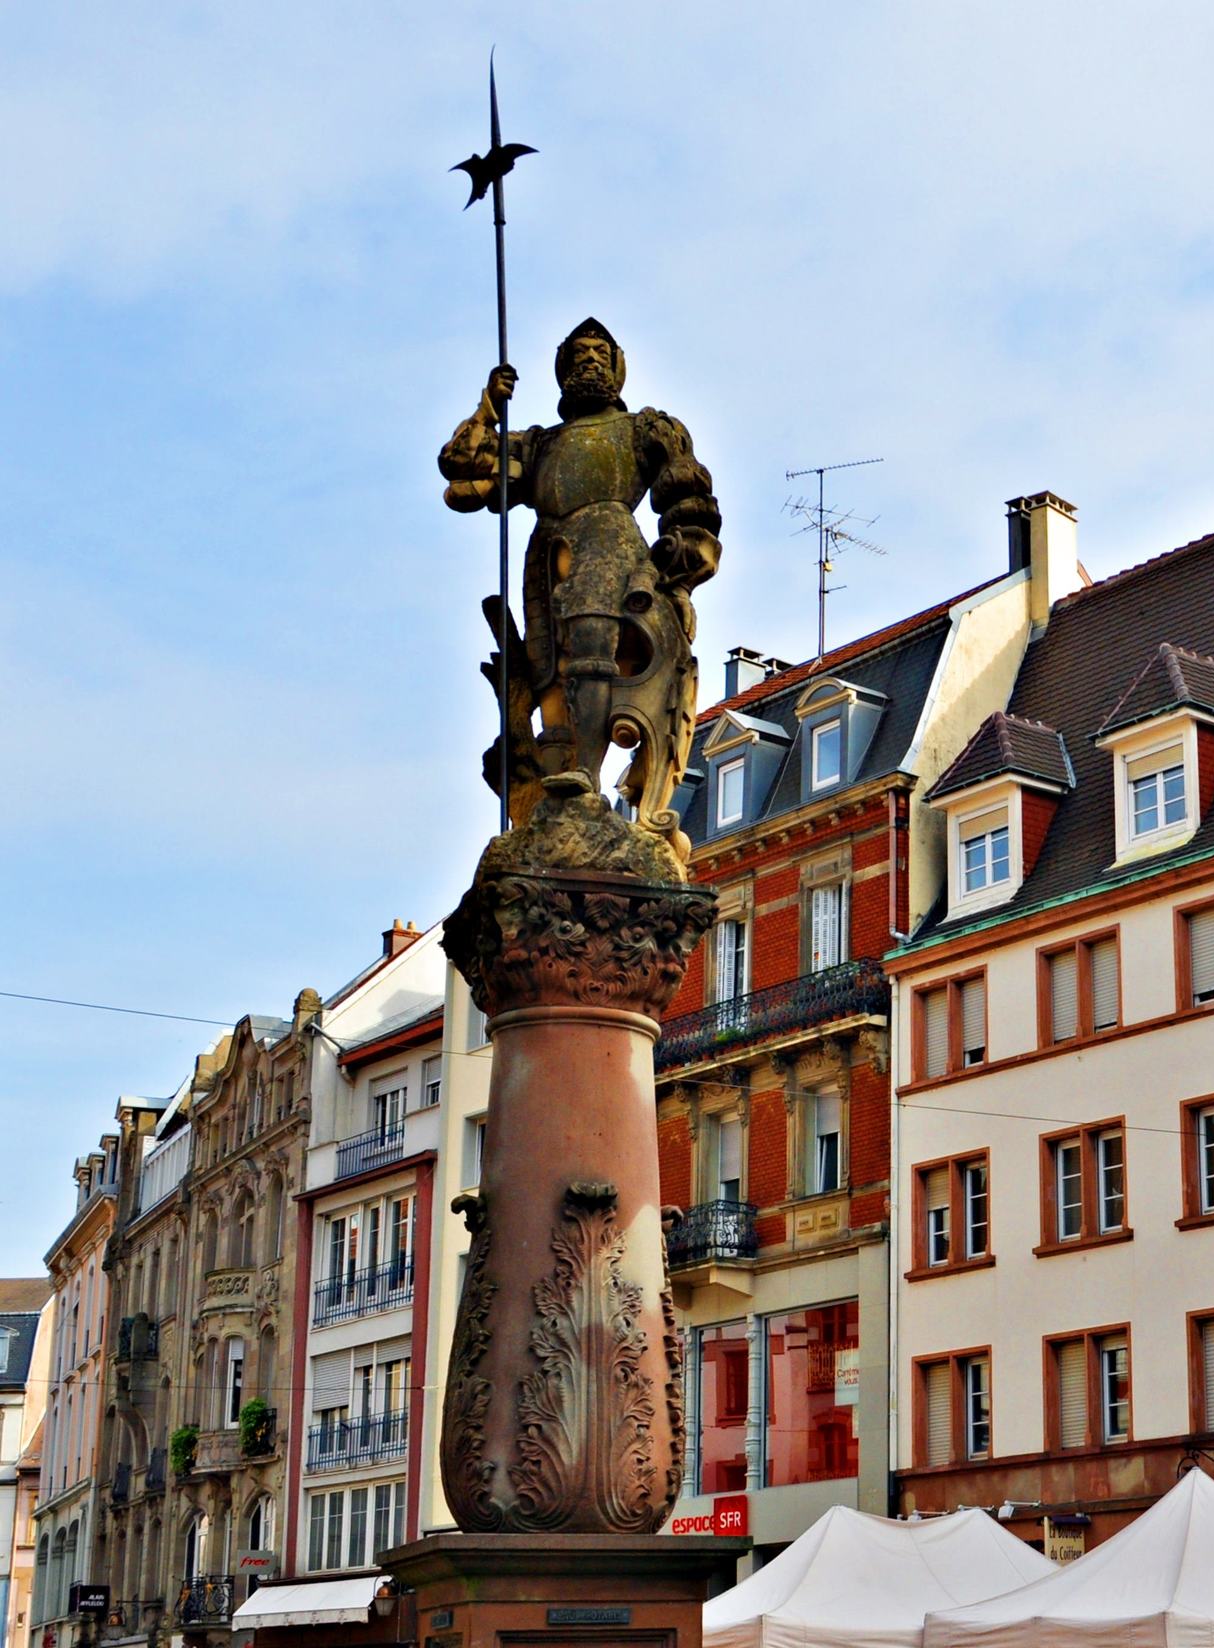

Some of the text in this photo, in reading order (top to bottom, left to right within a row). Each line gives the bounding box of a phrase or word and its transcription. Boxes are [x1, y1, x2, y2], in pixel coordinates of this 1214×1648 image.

[672, 1510, 742, 1535] espace SFR
[1050, 1545, 1058, 1561] du
[240, 1556, 270, 1568] free
